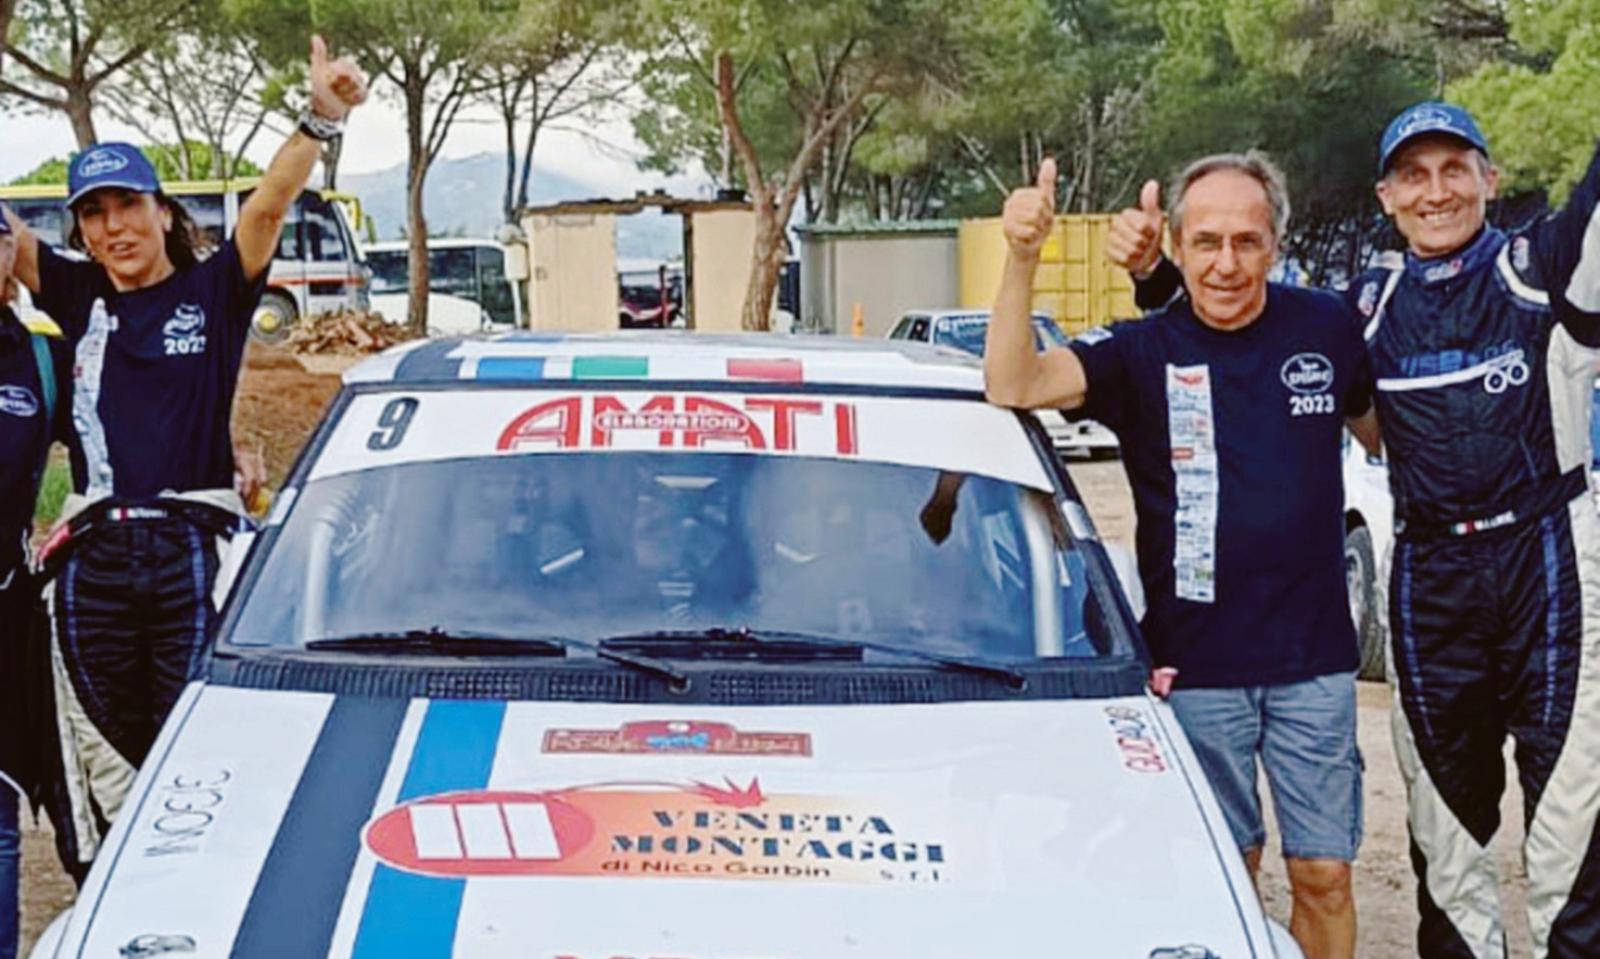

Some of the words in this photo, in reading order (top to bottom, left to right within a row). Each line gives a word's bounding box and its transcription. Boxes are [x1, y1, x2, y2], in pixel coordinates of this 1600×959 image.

[1289, 393, 1335, 416] 2023
[367, 398, 419, 452] 9
[495, 394, 859, 455] AMATI
[652, 810, 894, 835] VENETA
[610, 834, 945, 863] MONTAGGI
[601, 859, 629, 873] di
[641, 860, 713, 874] Nico
[724, 861, 831, 878] Garbin
